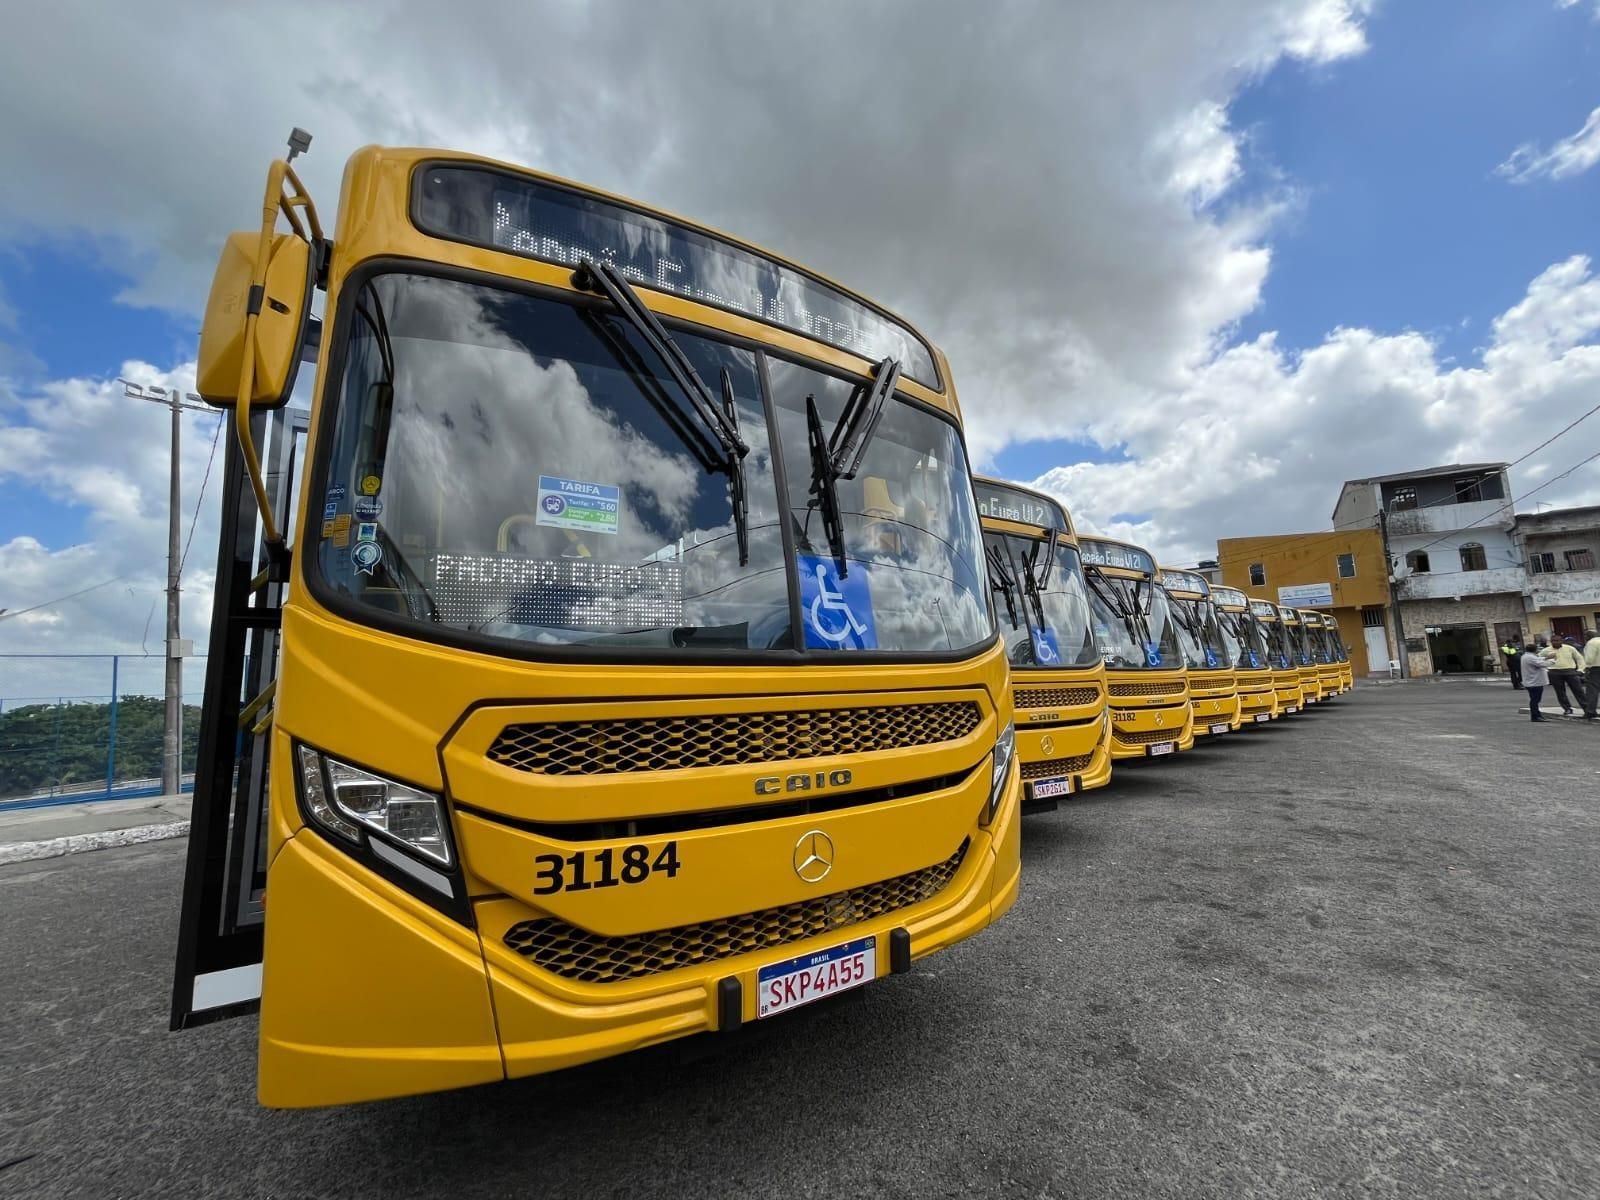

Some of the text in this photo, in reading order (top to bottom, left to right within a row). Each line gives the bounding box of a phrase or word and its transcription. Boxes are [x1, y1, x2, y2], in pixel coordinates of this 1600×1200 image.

[560, 481, 600, 495] TARIFA
[1029, 713, 1060, 721] CAIO
[1112, 712, 1137, 722] 31182
[755, 769, 852, 795] CAIO
[534, 841, 681, 895] 31184
[811, 953, 830, 965] BRASIL
[770, 953, 865, 1008] SKP4A55
